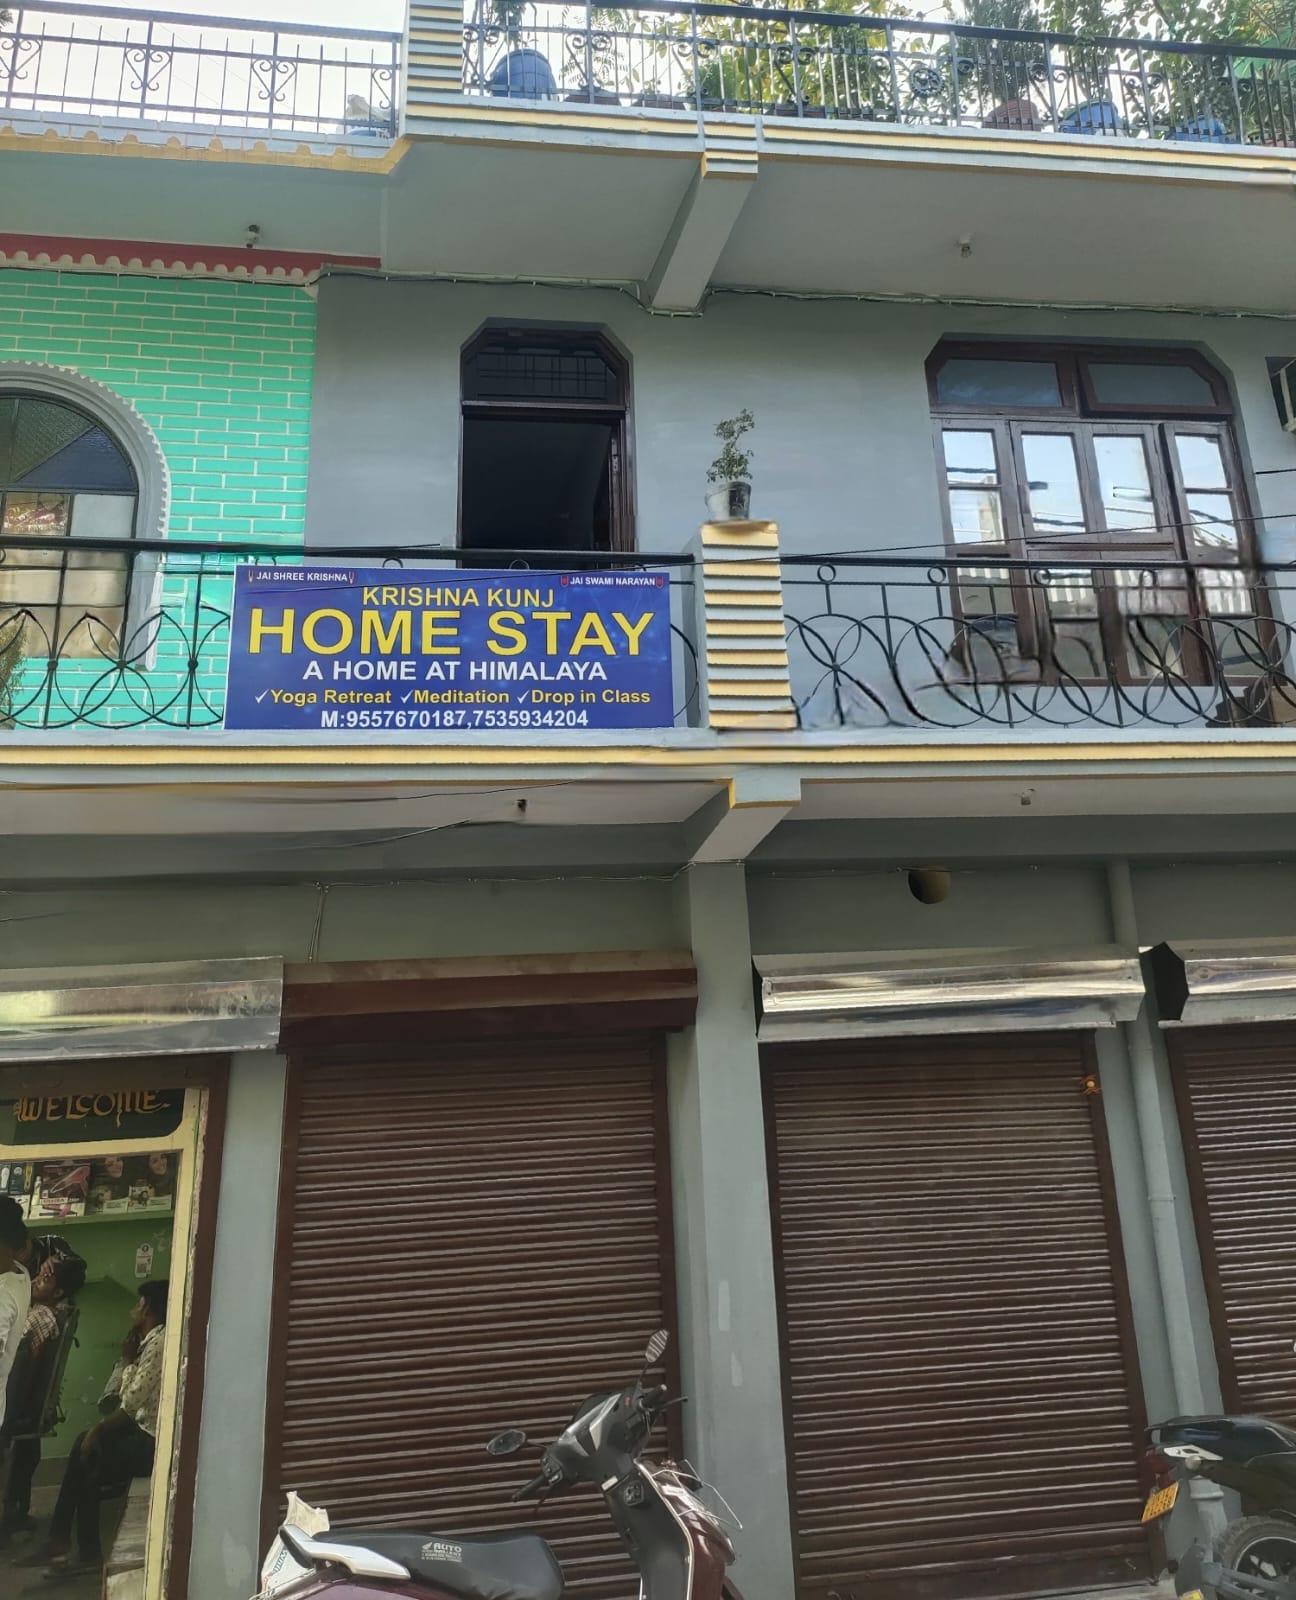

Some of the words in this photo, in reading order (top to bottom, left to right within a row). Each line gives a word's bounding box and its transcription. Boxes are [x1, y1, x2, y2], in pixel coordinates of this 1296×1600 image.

[256, 571, 271, 580] JAI
[273, 571, 304, 581] SHREE
[307, 572, 348, 582] KRISHNA
[570, 576, 584, 585] JAI
[585, 576, 614, 586] SWAMI
[615, 577, 655, 586] NARAYAN
[362, 586, 480, 606] KRISHNA
[487, 588, 554, 608] KUNJ
[249, 608, 461, 655] HOME
[486, 610, 655, 656] STAY
[302, 660, 324, 680] A
[333, 660, 417, 681] HOME
[425, 661, 461, 680] AT
[469, 661, 608, 681] HIMALAYA
[270, 689, 317, 707] Yoga
[324, 689, 392, 704] Retreat
[413, 689, 510, 704] Meditation
[531, 689, 575, 706] Drop
[580, 689, 596, 704] in
[601, 689, 651, 704] Class
[433, 1542, 462, 1553] AUTO
